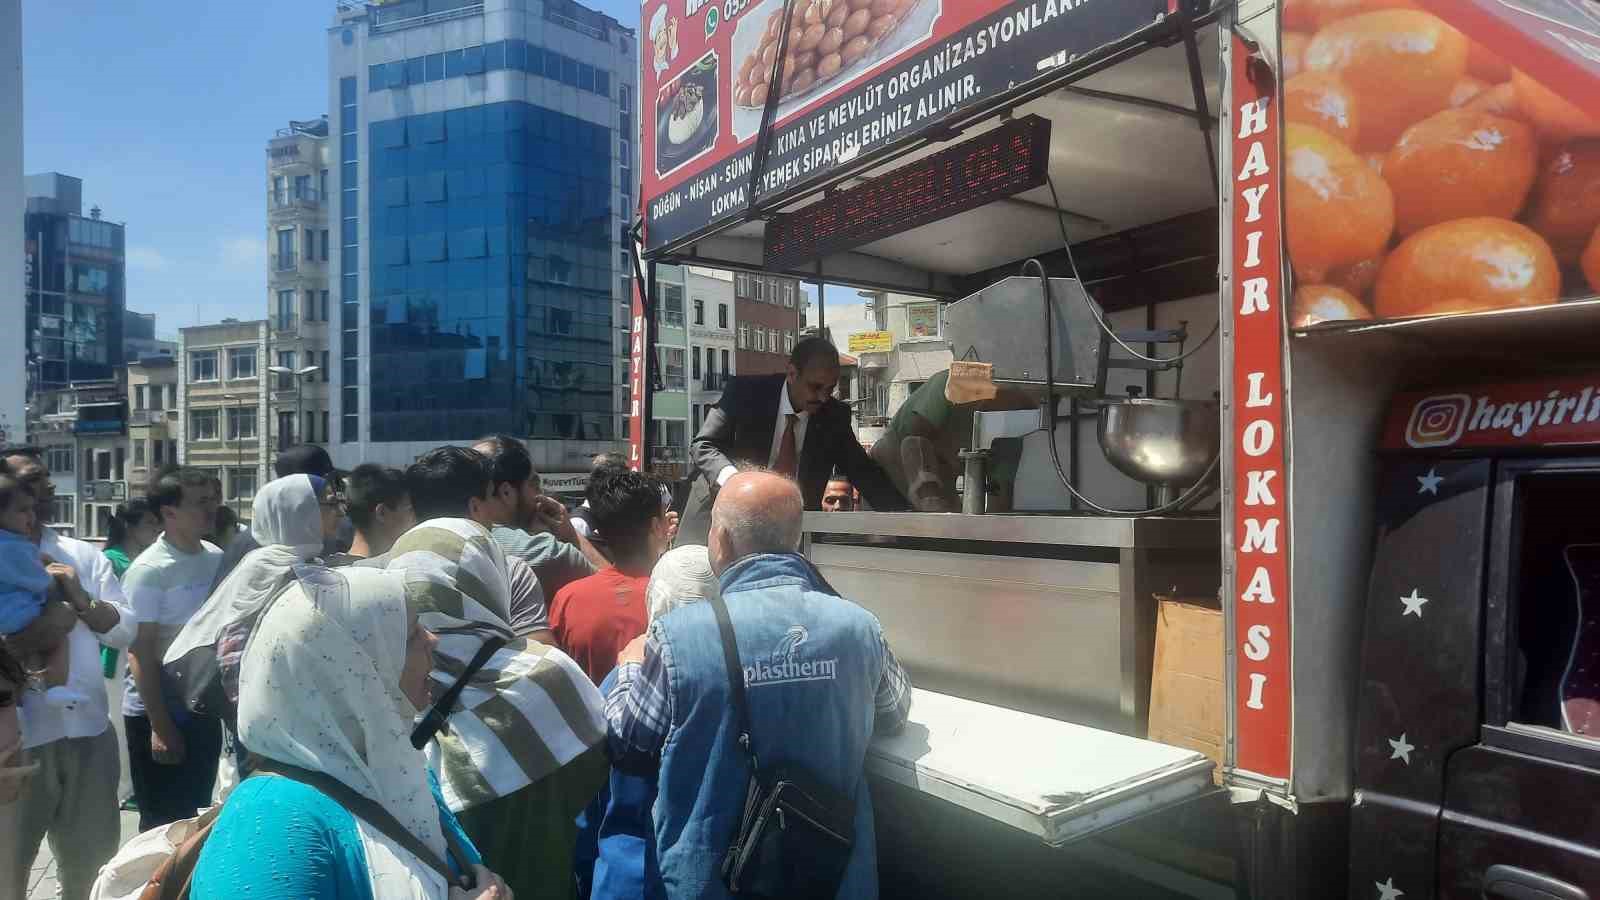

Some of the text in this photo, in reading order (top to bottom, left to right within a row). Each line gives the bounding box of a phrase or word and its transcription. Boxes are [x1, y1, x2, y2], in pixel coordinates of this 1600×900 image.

[653, 191, 681, 220] DÜĞÜN
[689, 173, 717, 201] NİŞAN
[777, 125, 806, 156] KINA
[809, 114, 826, 140] VE
[828, 84, 884, 131] MEVLÜT
[887, 0, 1089, 100] ORGANİZASYONLAR
[711, 186, 745, 217] LOKMA
[762, 157, 801, 192] YEMEK
[916, 73, 982, 121] ALINIR.
[631, 316, 642, 417] HAYIR
[1237, 100, 1280, 710] HAYIR LOKMASI
[743, 656, 840, 689] plastherm
